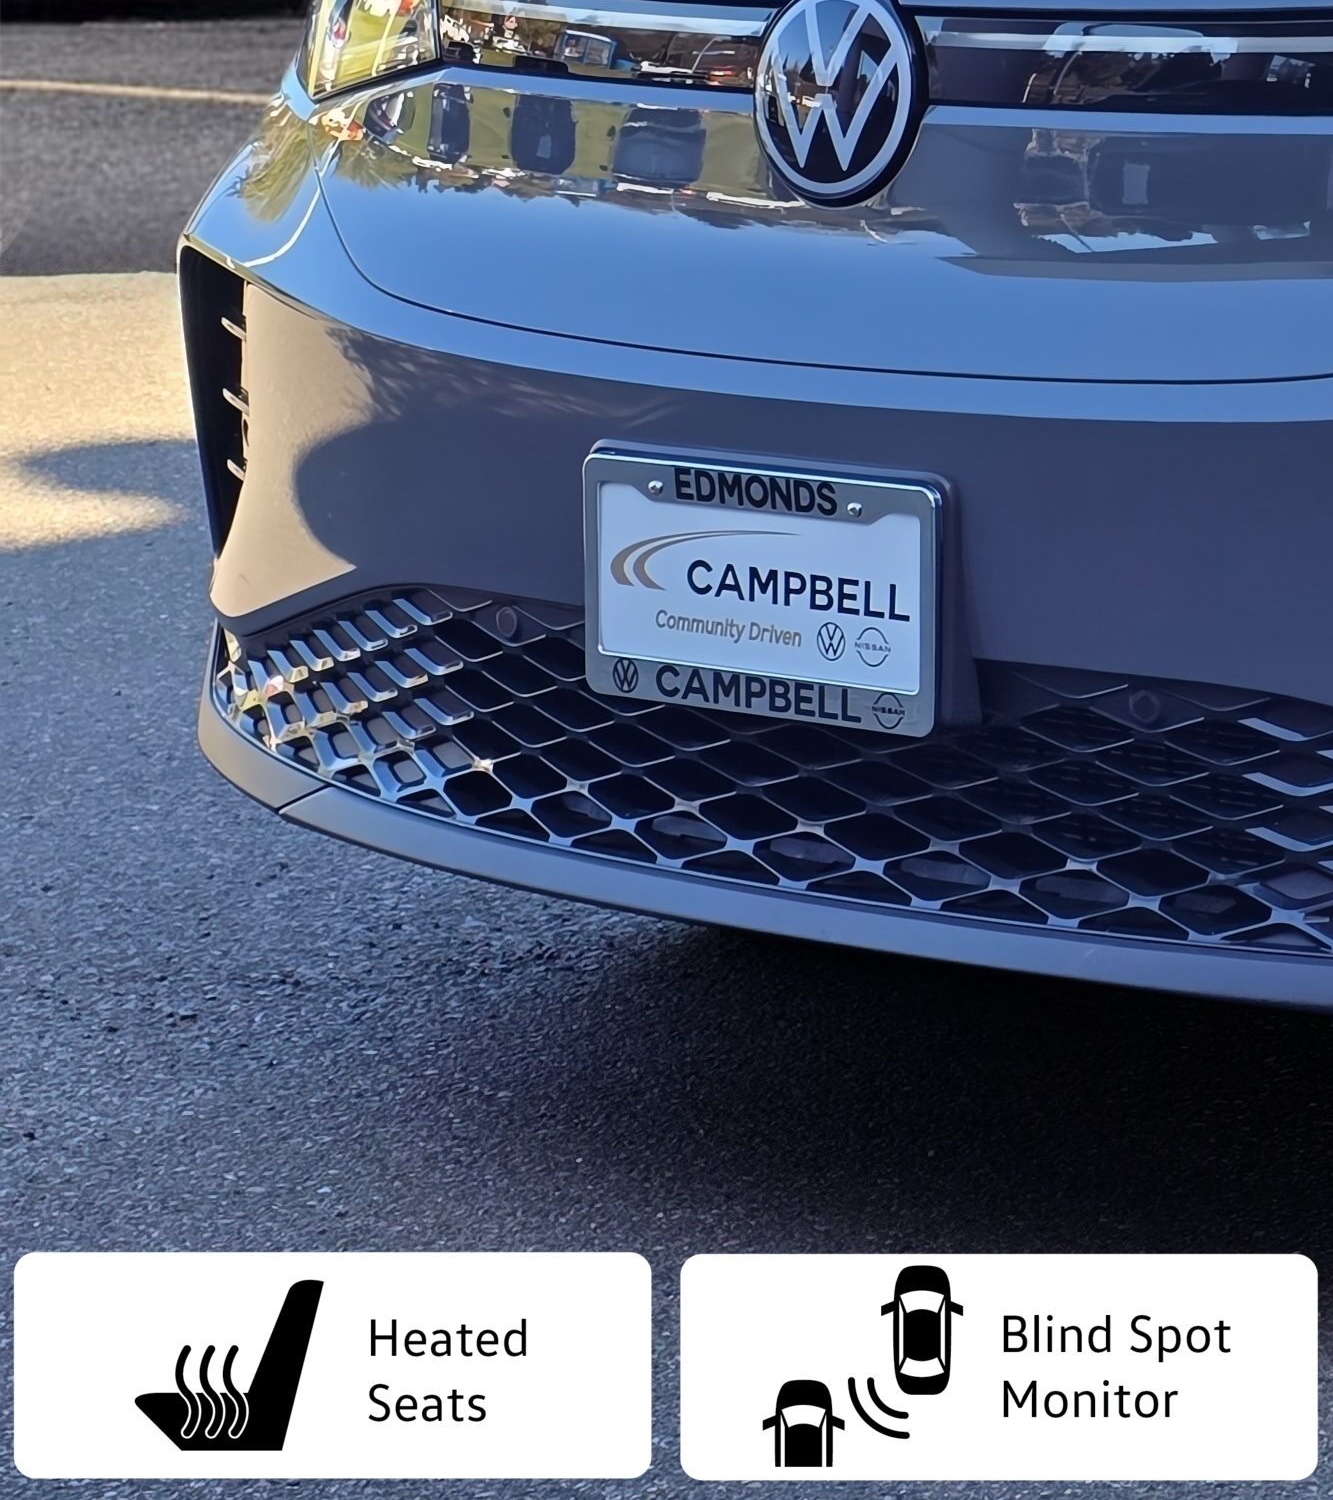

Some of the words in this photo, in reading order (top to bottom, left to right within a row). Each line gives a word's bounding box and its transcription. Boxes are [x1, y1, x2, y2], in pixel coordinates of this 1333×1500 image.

[673, 466, 839, 517] EDMONDS
[686, 558, 911, 622] CAMPBELL
[654, 608, 746, 644] Community
[748, 621, 803, 648] Driven
[655, 664, 862, 723] CAMPBELL
